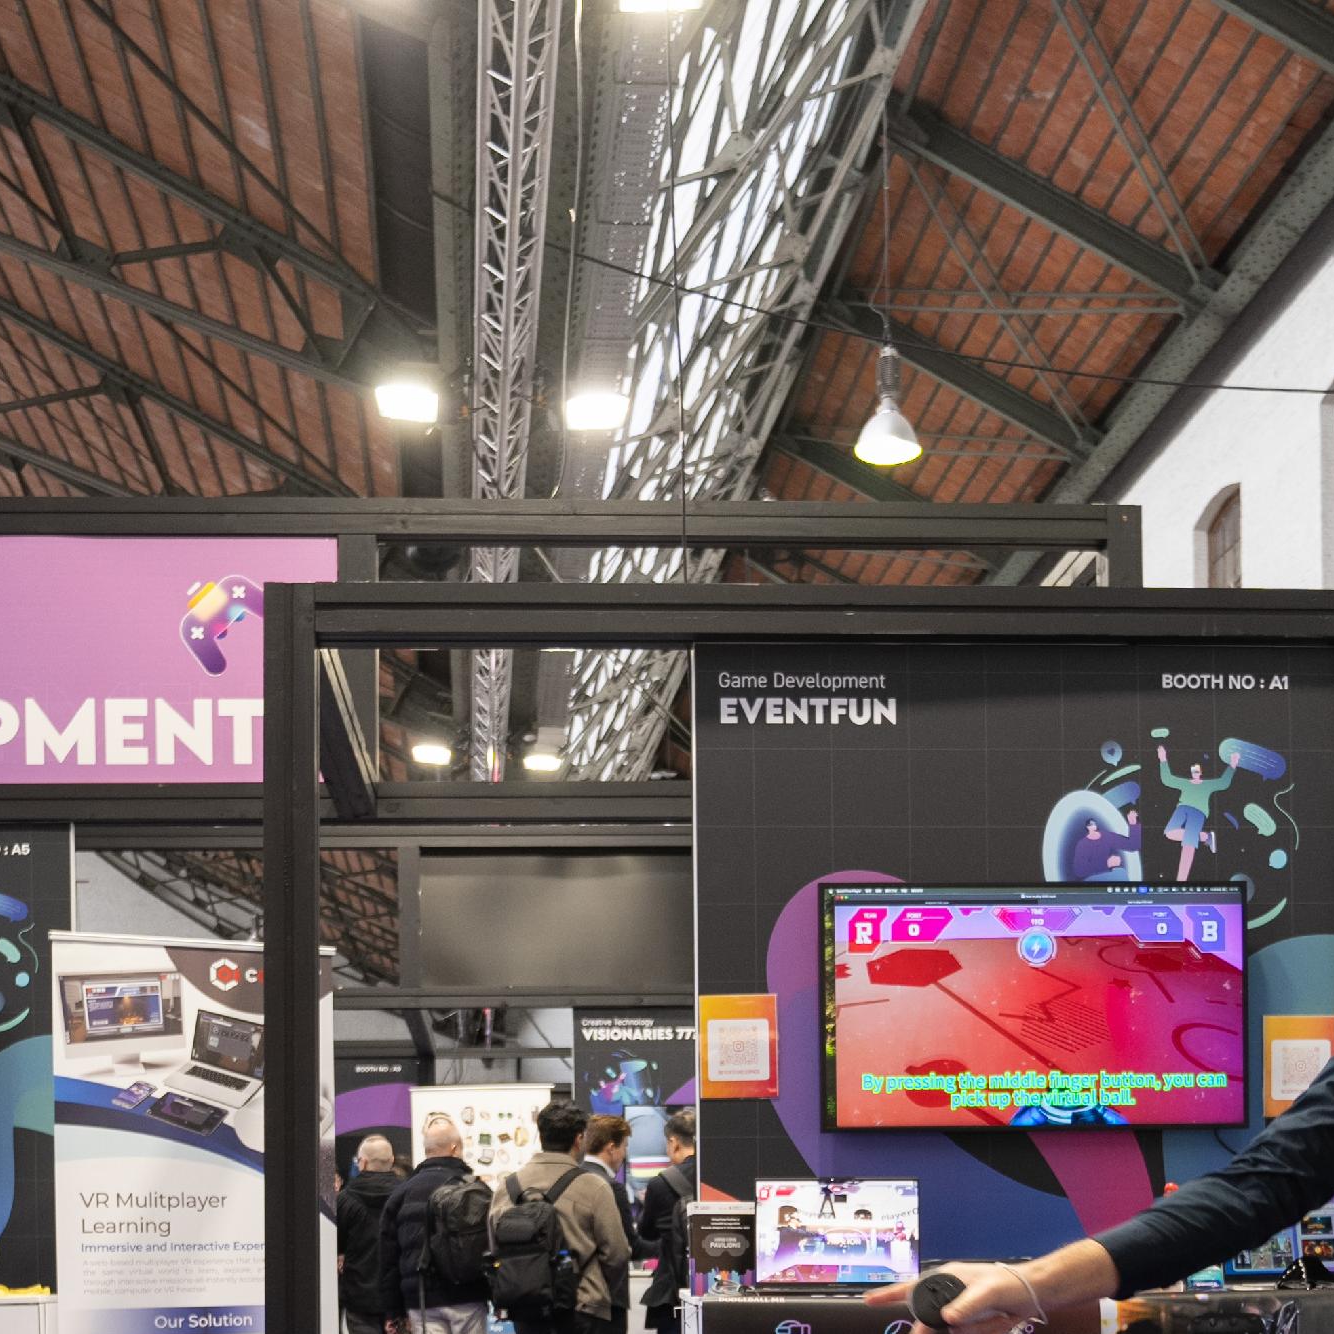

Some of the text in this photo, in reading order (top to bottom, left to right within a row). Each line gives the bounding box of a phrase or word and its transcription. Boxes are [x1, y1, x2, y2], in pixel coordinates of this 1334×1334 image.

[718, 672, 886, 692] Game Development
[1162, 673, 1289, 690] BOOTH NO A1
[720, 696, 897, 725] EVENTFUN
[11, 843, 31, 857] A5
[855, 922, 874, 945] R
[1201, 920, 1218, 943] B
[581, 1027, 673, 1041] VISIONARIES
[862, 1072, 1227, 1092] By pressing the middle finger button, you can
[950, 1090, 1136, 1109] pick up the virtual ball.
[80, 1191, 227, 1212] VR Mulitplayer
[82, 1217, 171, 1238] Learning
[81, 1241, 265, 1253] Immersive and Interactive Exper
[154, 1313, 253, 1329] Our Solution
